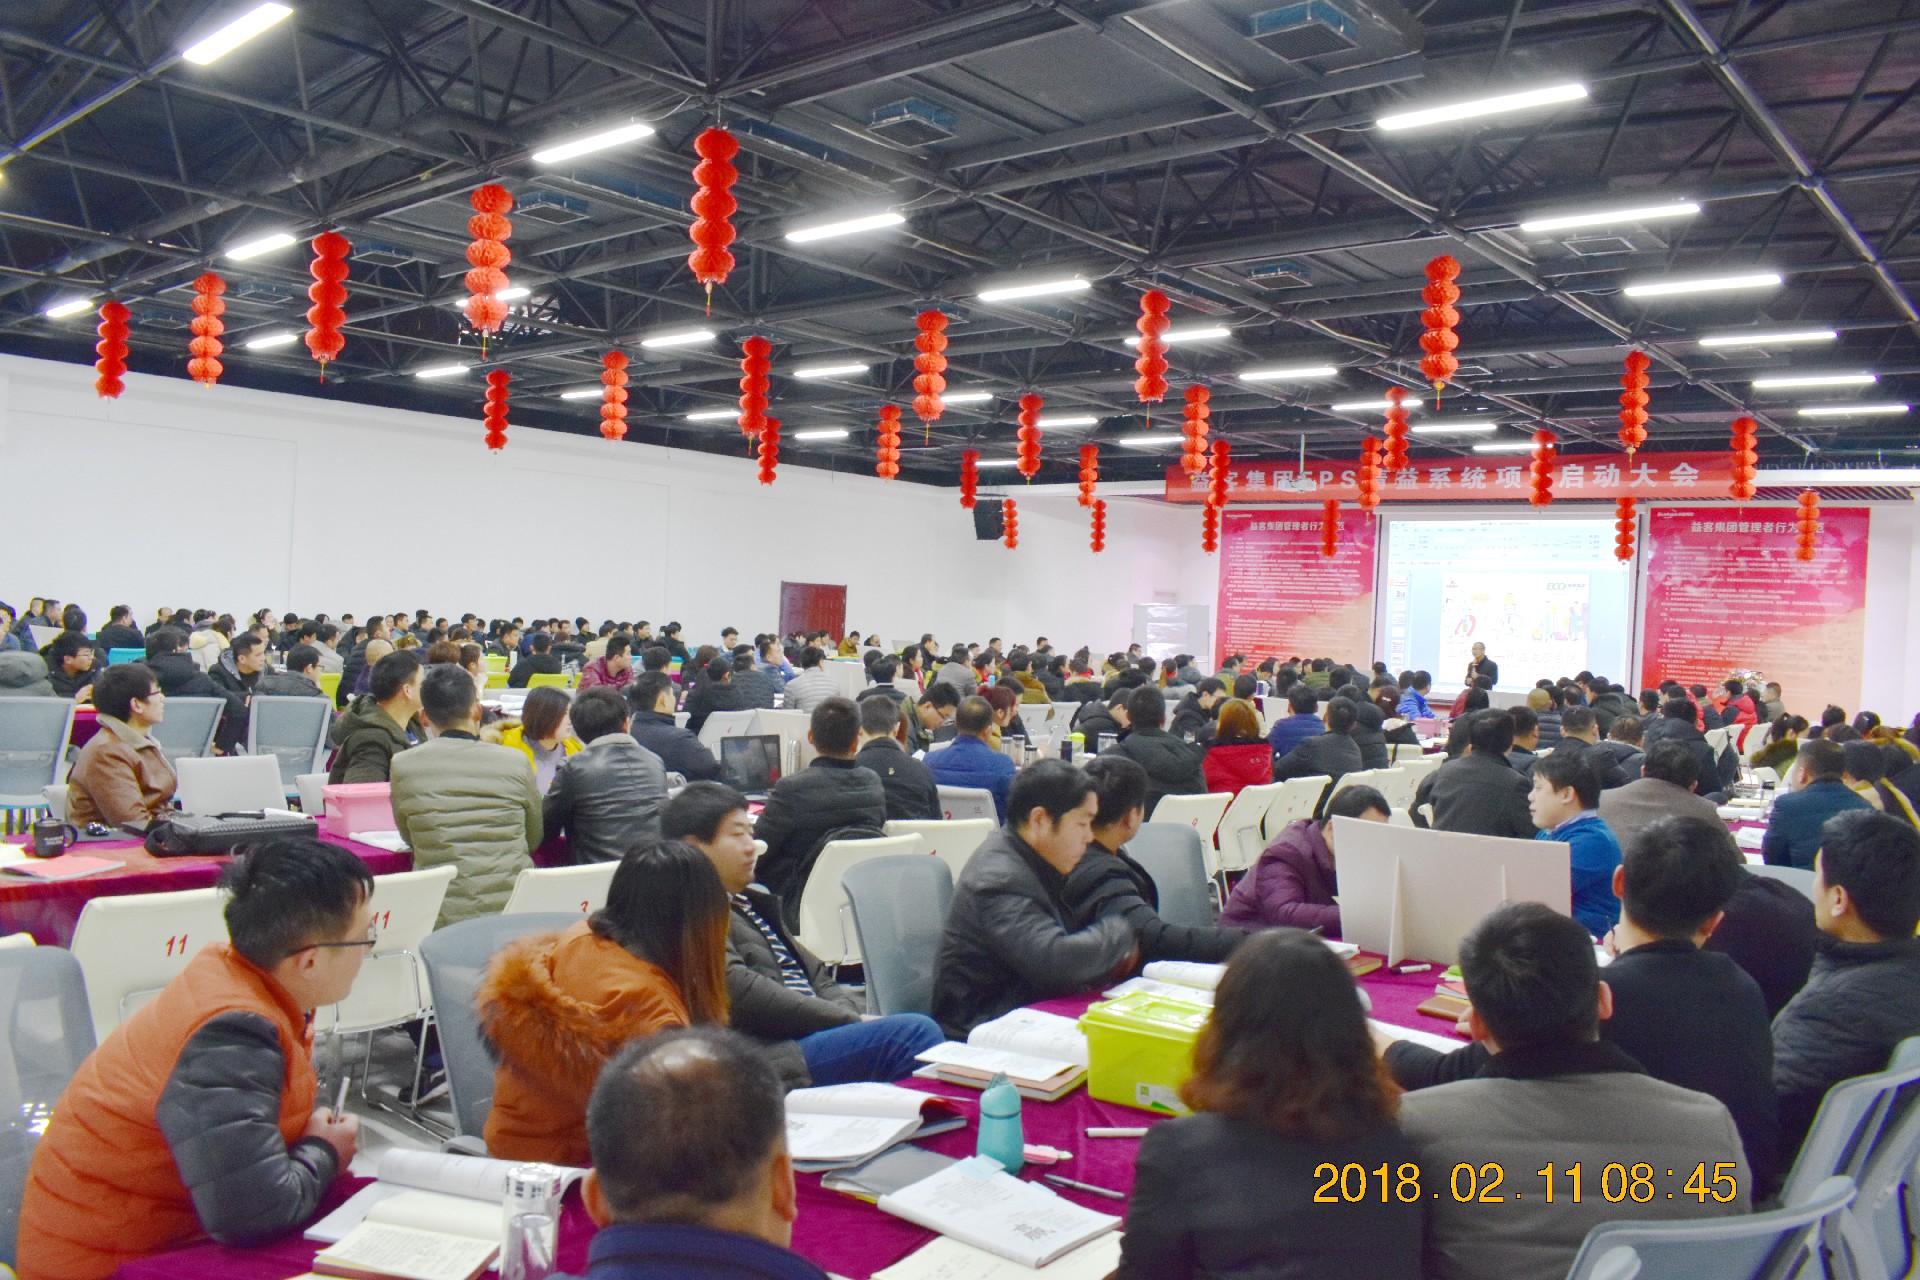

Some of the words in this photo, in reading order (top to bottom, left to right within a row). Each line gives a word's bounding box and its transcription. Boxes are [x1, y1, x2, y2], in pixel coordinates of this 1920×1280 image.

[1691, 521, 1825, 533] 益客集团管理者行为范
[166, 934, 188, 957] 11
